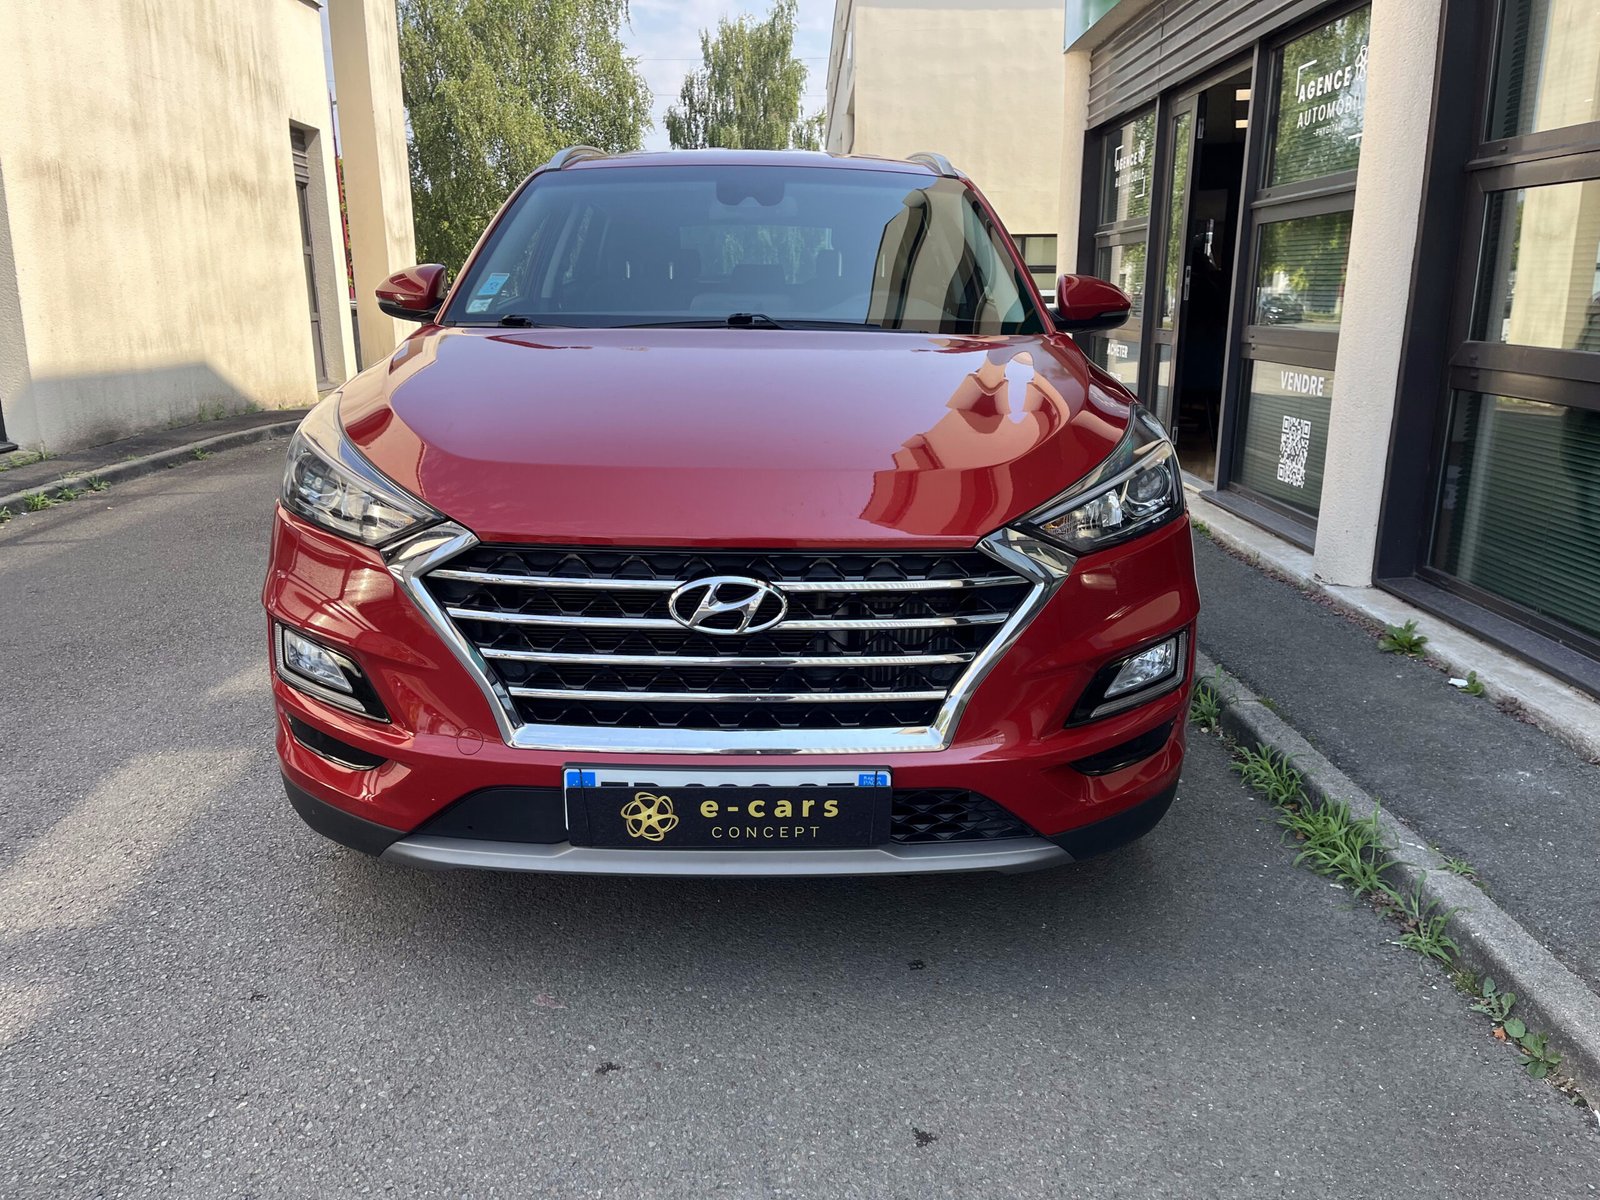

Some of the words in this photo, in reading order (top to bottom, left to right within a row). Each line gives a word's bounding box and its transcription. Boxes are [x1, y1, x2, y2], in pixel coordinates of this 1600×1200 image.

[1297, 65, 1352, 104] AGENCE
[1296, 92, 1363, 129] AUTOMOBIL
[1280, 370, 1325, 397] VENDRE
[700, 799, 839, 818] e-cars
[711, 826, 820, 839] CONCEPT
